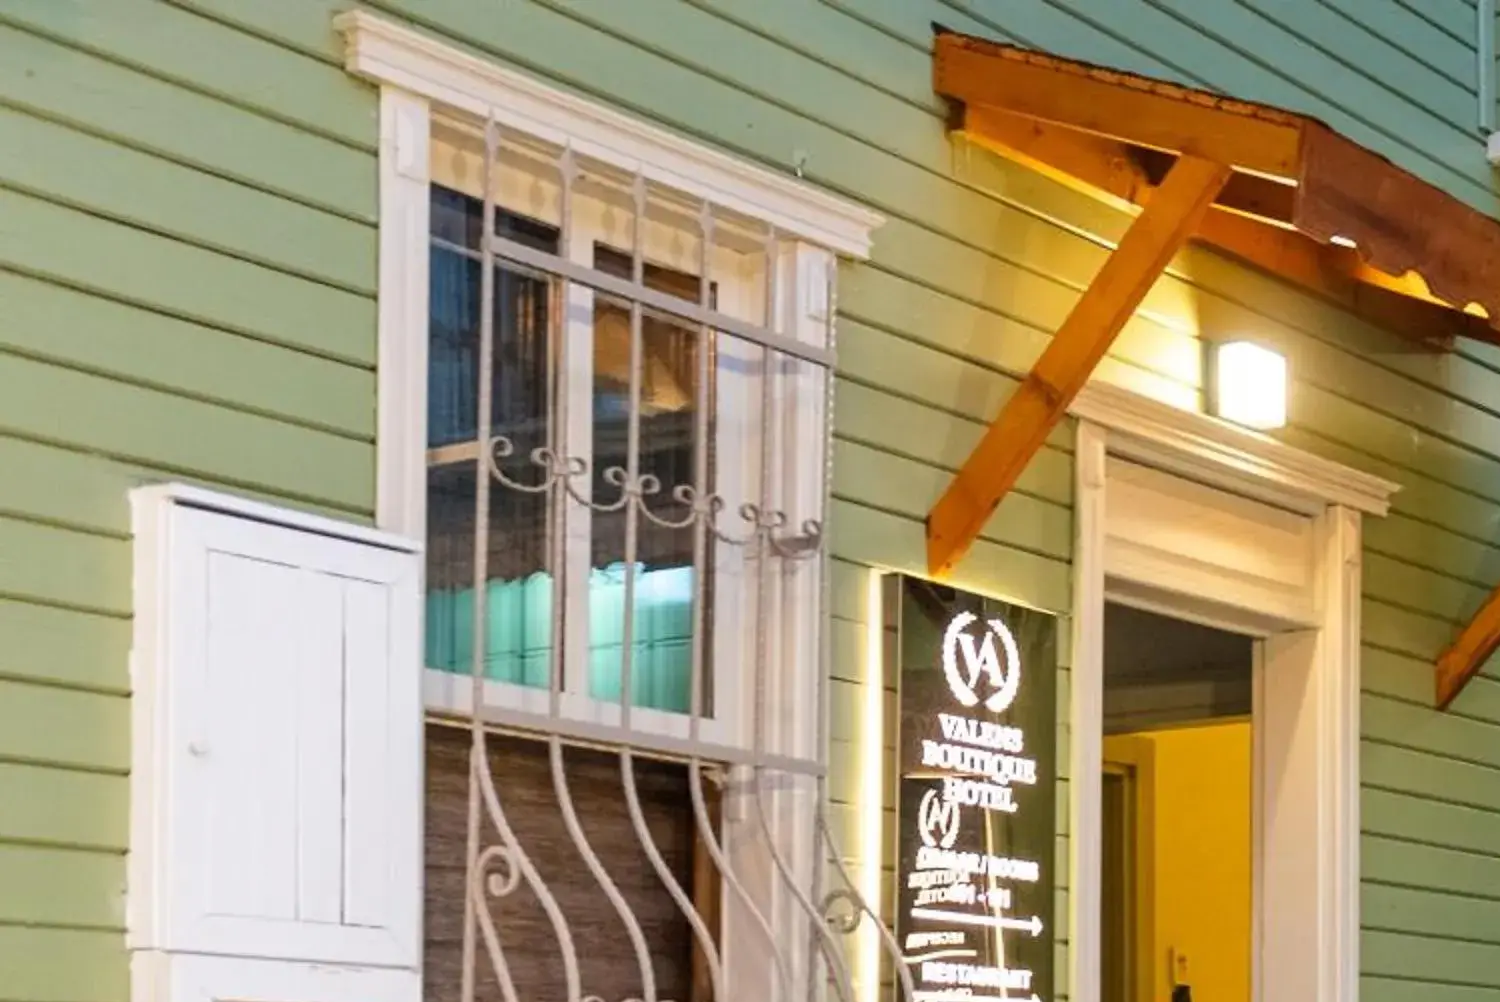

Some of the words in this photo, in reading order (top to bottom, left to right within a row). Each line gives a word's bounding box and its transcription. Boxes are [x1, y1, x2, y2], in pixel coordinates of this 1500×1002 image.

[939, 713, 1023, 752] VALENS
[921, 740, 1037, 785] BOUTIQUE
[943, 777, 1018, 812] HOTEL
